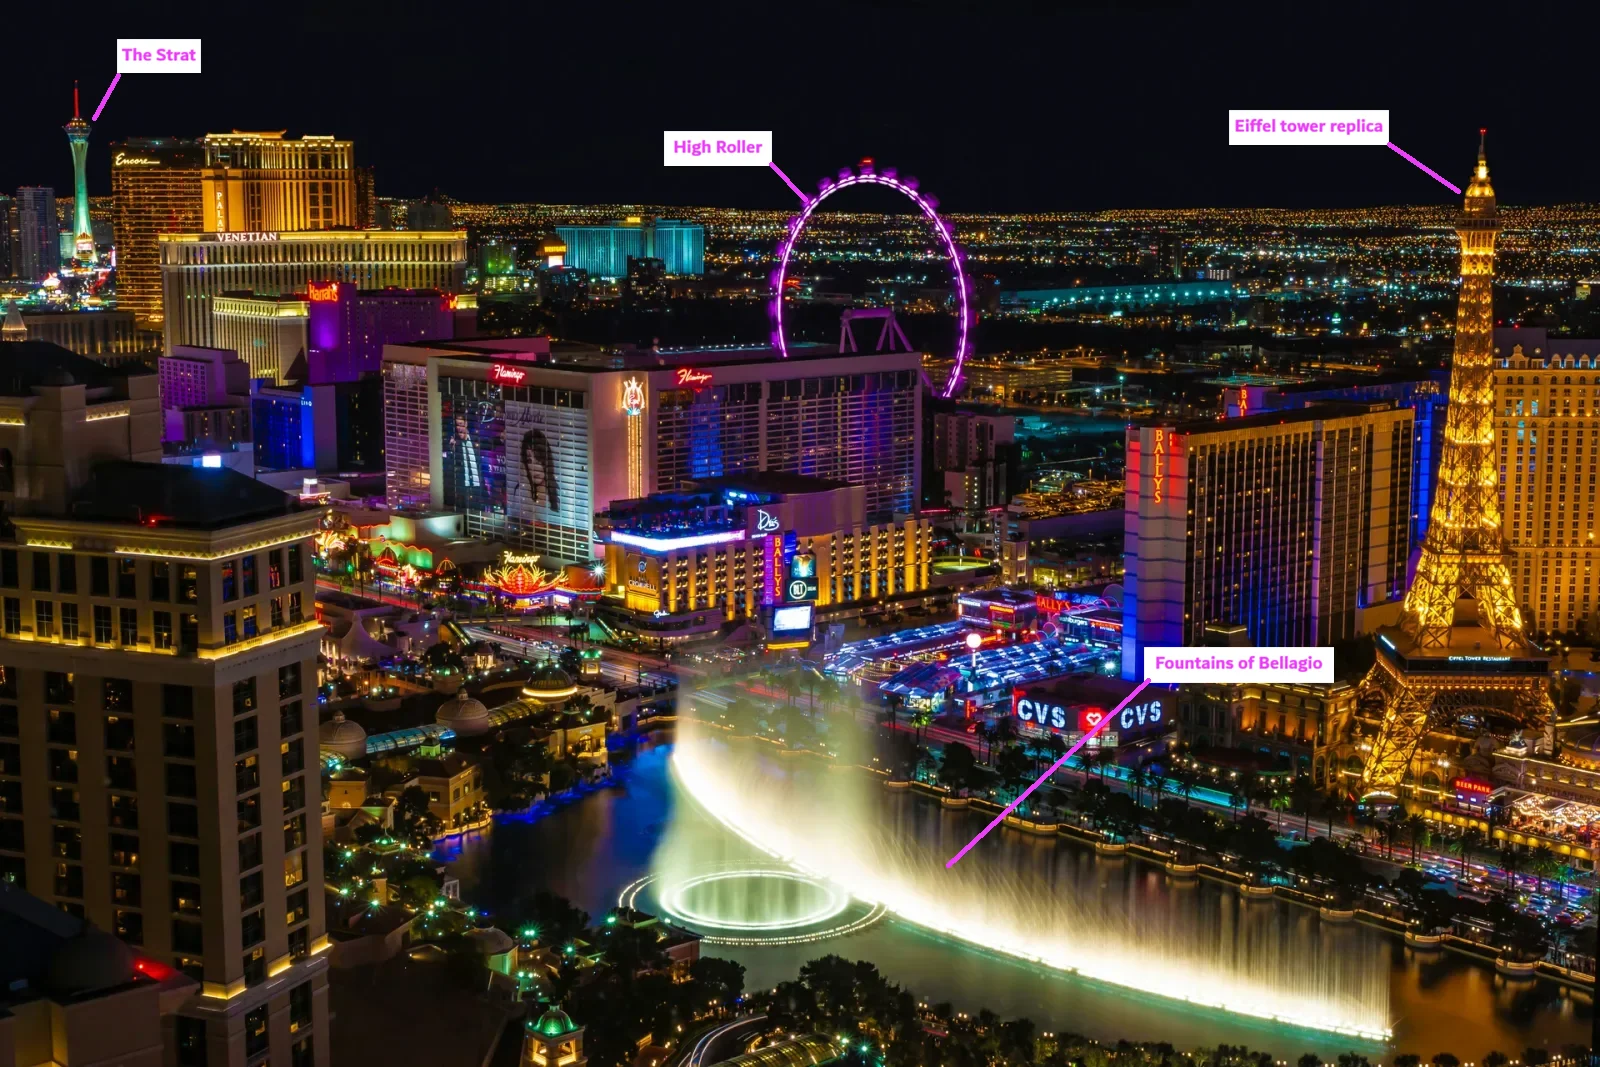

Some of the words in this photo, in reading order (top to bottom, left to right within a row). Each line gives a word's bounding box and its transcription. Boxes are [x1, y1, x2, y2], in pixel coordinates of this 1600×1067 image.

[115, 152, 160, 166] Encore
[217, 232, 277, 242] VENETIAN
[494, 364, 525, 383] Flamingo
[677, 368, 712, 384] Flamingo
[1154, 430, 1164, 503] BALLYS
[504, 550, 540, 566] Flamingo
[774, 537, 782, 596] BALLYS
[1018, 699, 1065, 728] CVS
[1121, 701, 1161, 729] CVS
[1456, 781, 1472, 789] BEER
[1473, 784, 1490, 793] PARK
